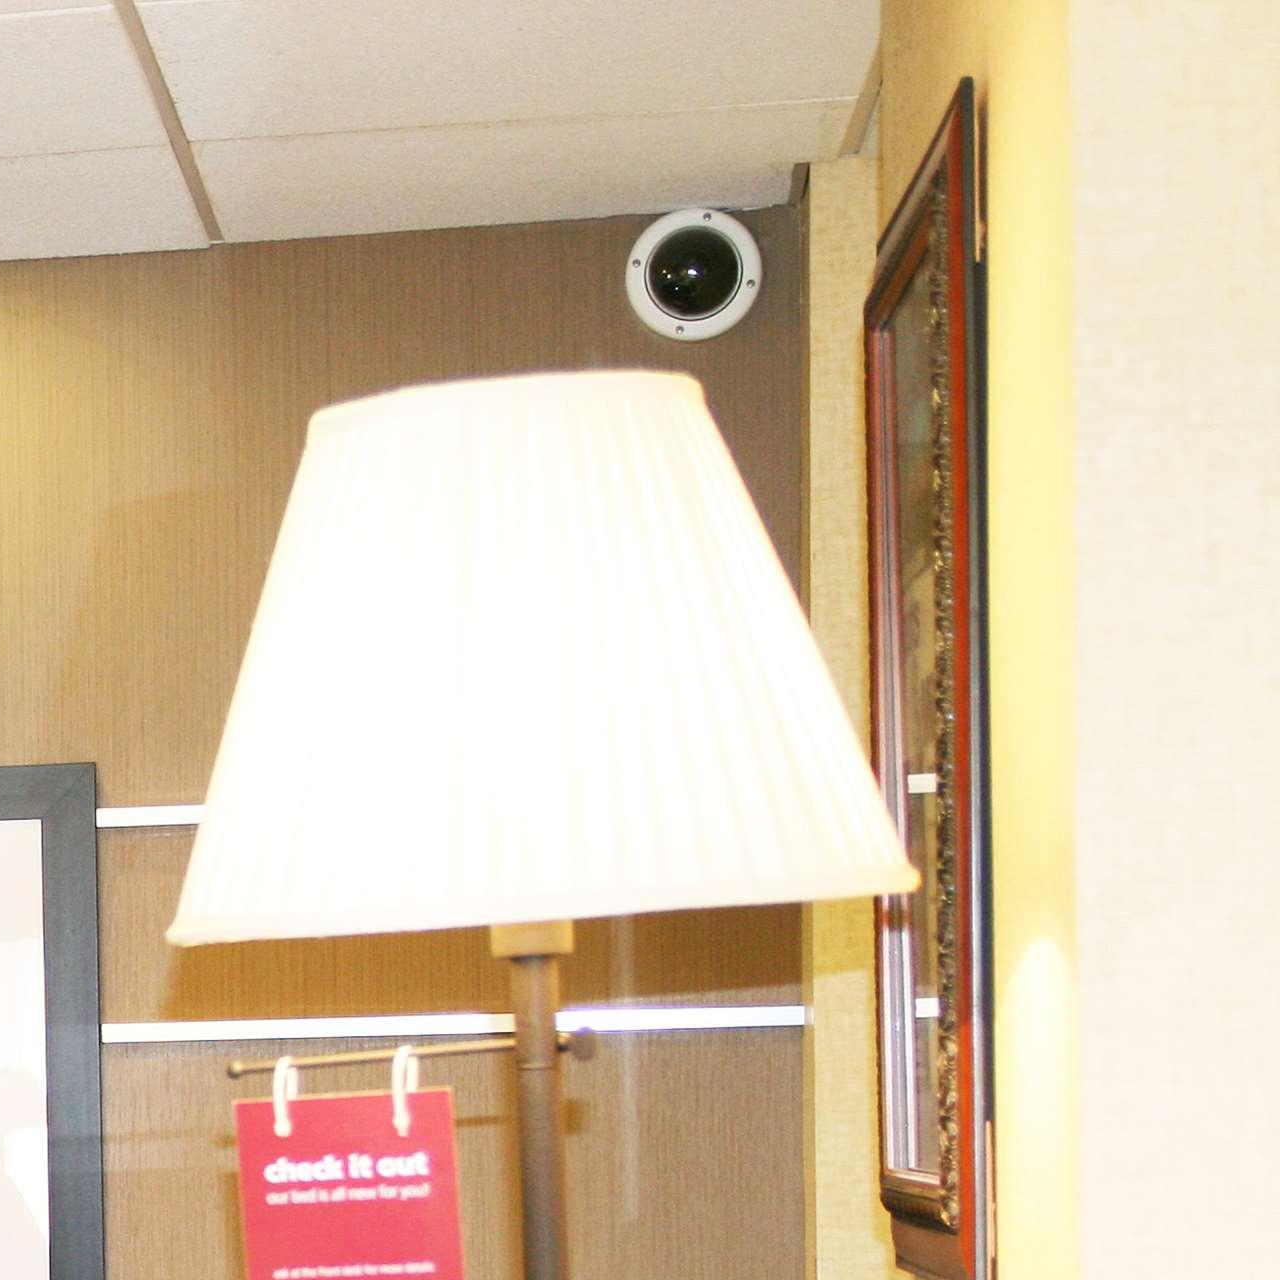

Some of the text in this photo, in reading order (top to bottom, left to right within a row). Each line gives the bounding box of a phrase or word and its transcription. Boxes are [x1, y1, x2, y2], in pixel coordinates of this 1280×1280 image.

[264, 1150, 431, 1184] check it out
